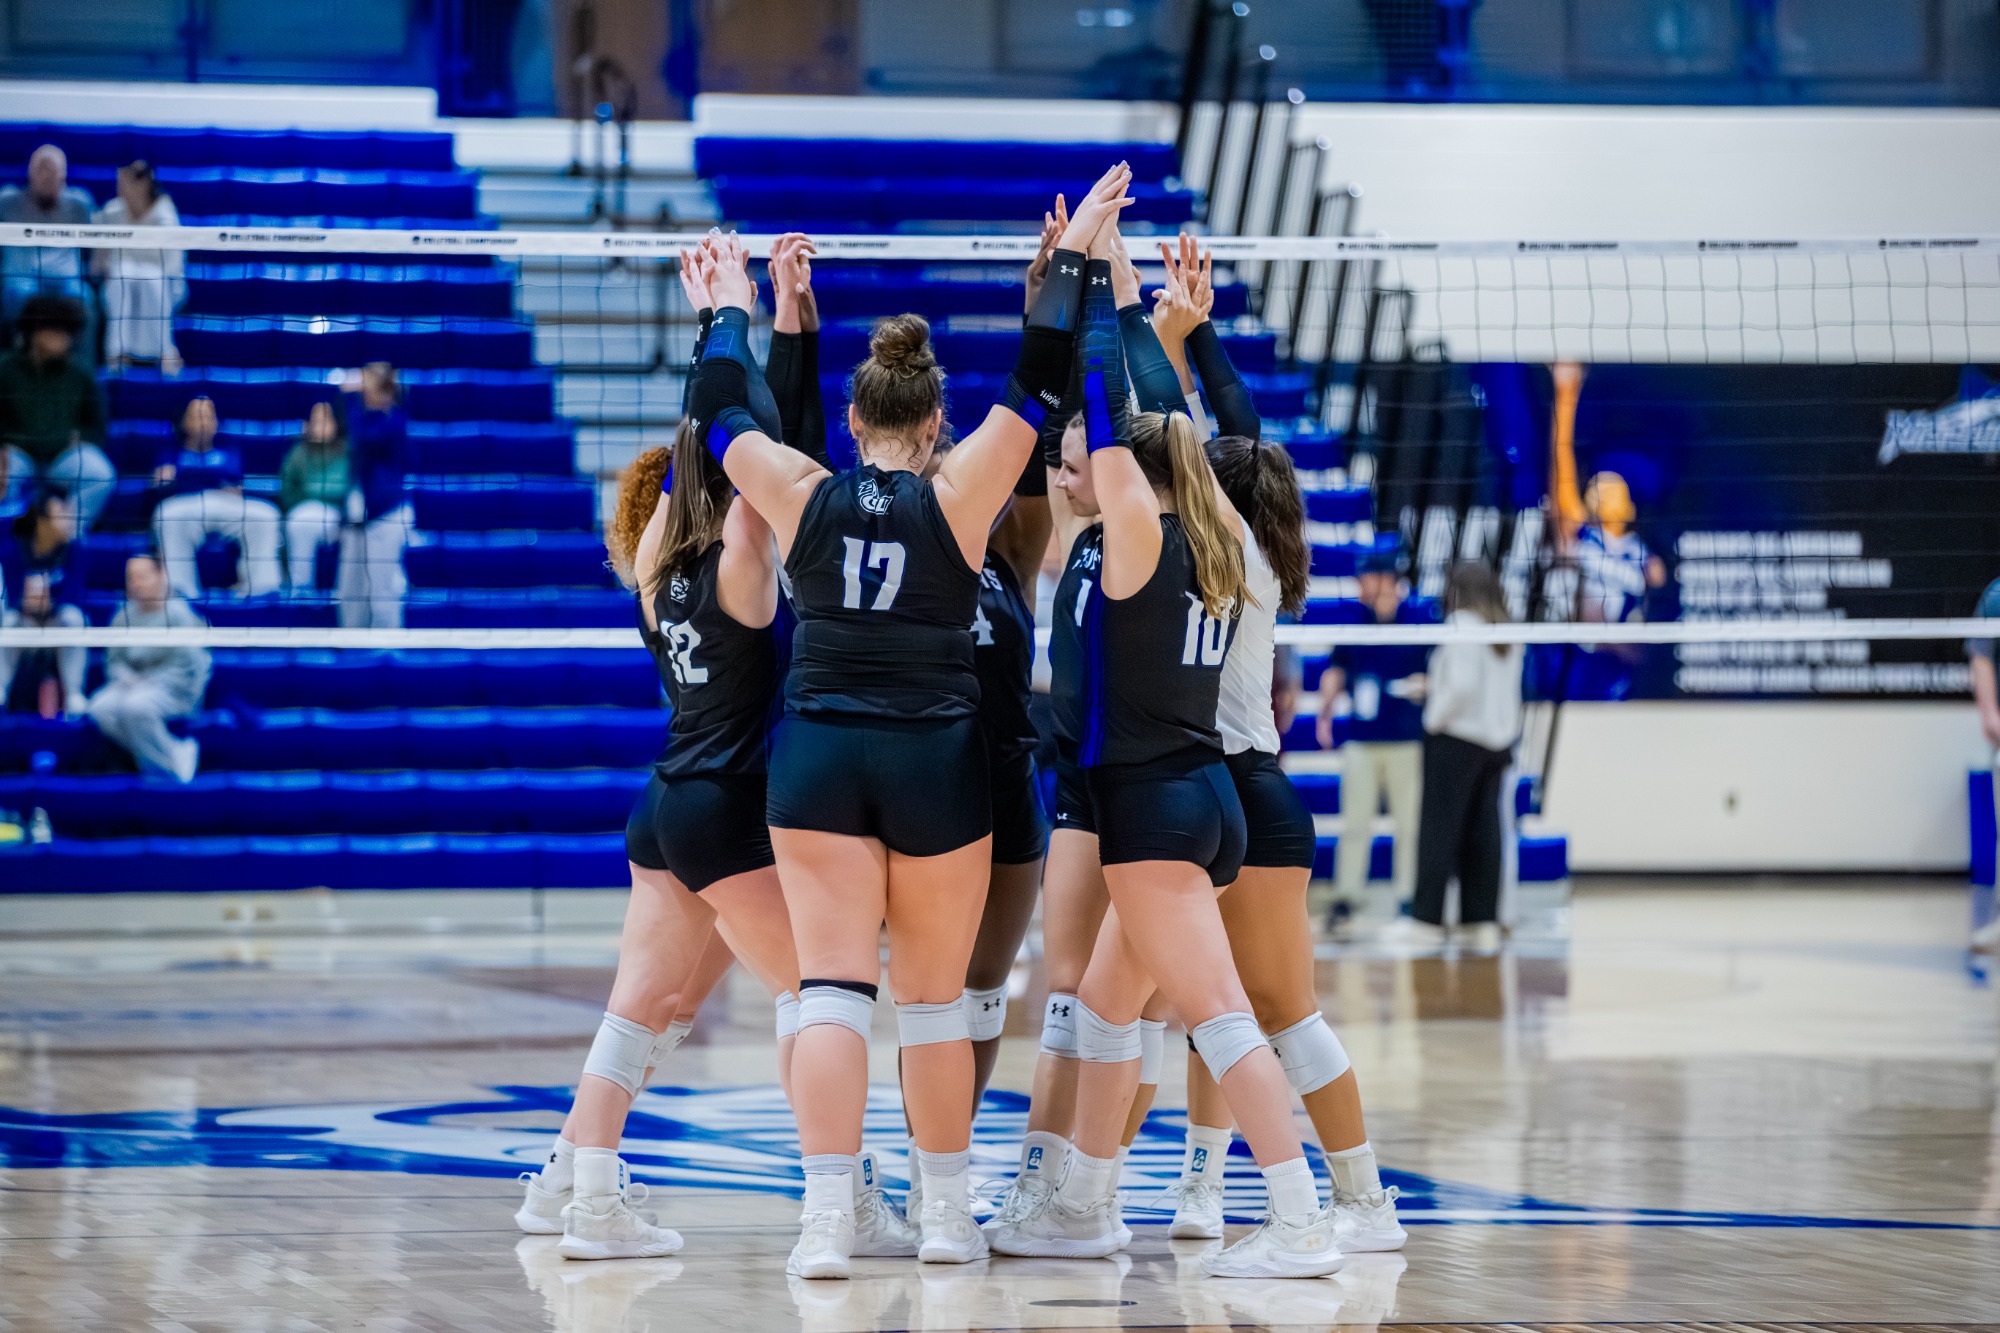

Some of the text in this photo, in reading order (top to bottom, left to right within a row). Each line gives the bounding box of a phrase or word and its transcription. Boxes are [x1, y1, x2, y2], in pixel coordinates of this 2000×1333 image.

[843, 536, 906, 611] 17
[660, 619, 709, 684] 12
[1182, 590, 1236, 666] 10
